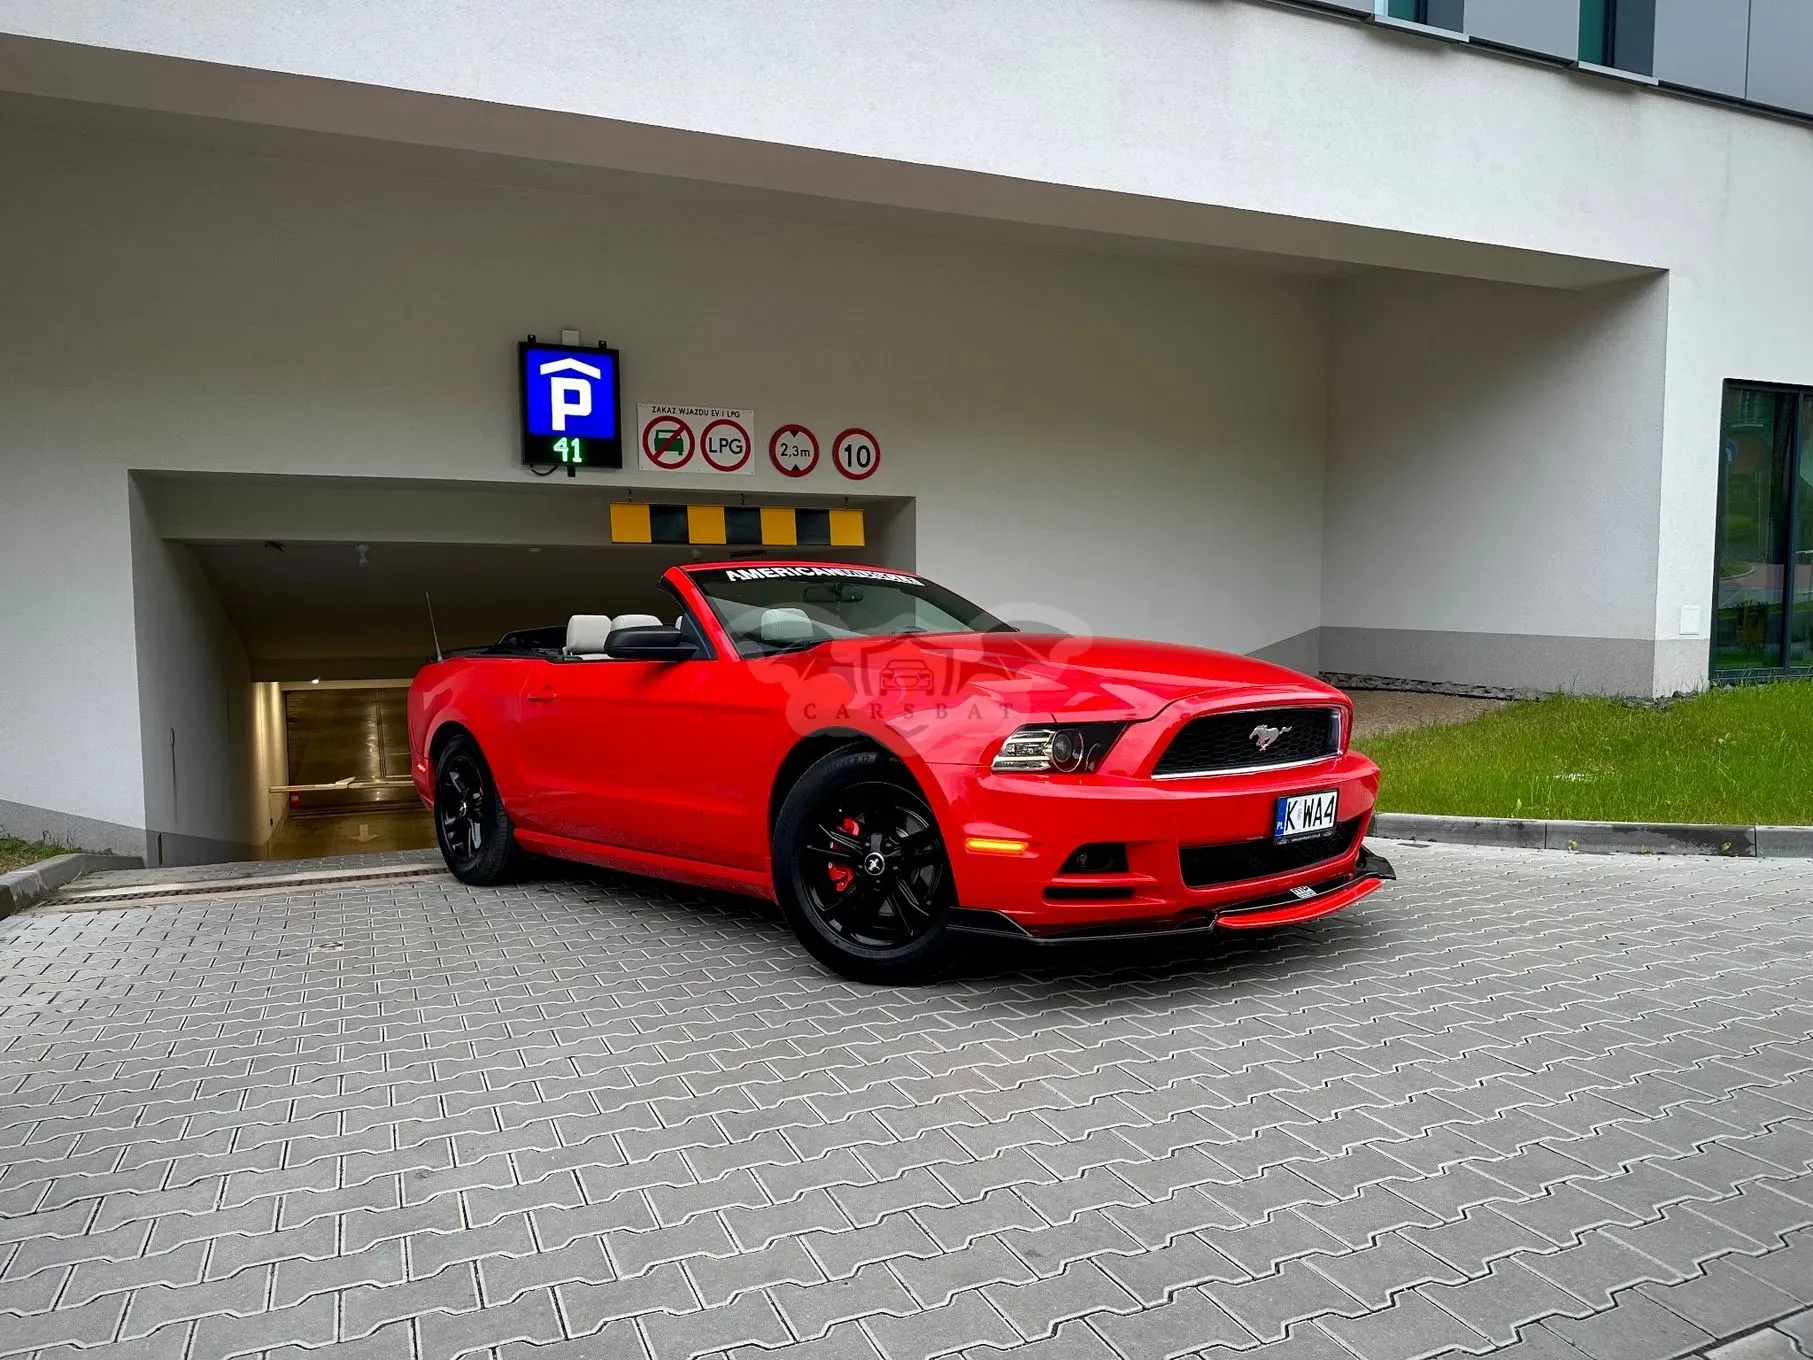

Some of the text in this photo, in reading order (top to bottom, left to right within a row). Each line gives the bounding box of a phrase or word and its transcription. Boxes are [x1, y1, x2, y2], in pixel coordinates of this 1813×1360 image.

[550, 376, 592, 432] P
[651, 405, 677, 414] ZAKAZ
[678, 407, 709, 416] WJAZDU
[711, 409, 720, 417] EV
[726, 410, 741, 418] LPG
[553, 437, 583, 463] 41
[708, 438, 743, 455] LPG
[843, 444, 872, 468] 10
[1285, 795, 1335, 831] K WA4
